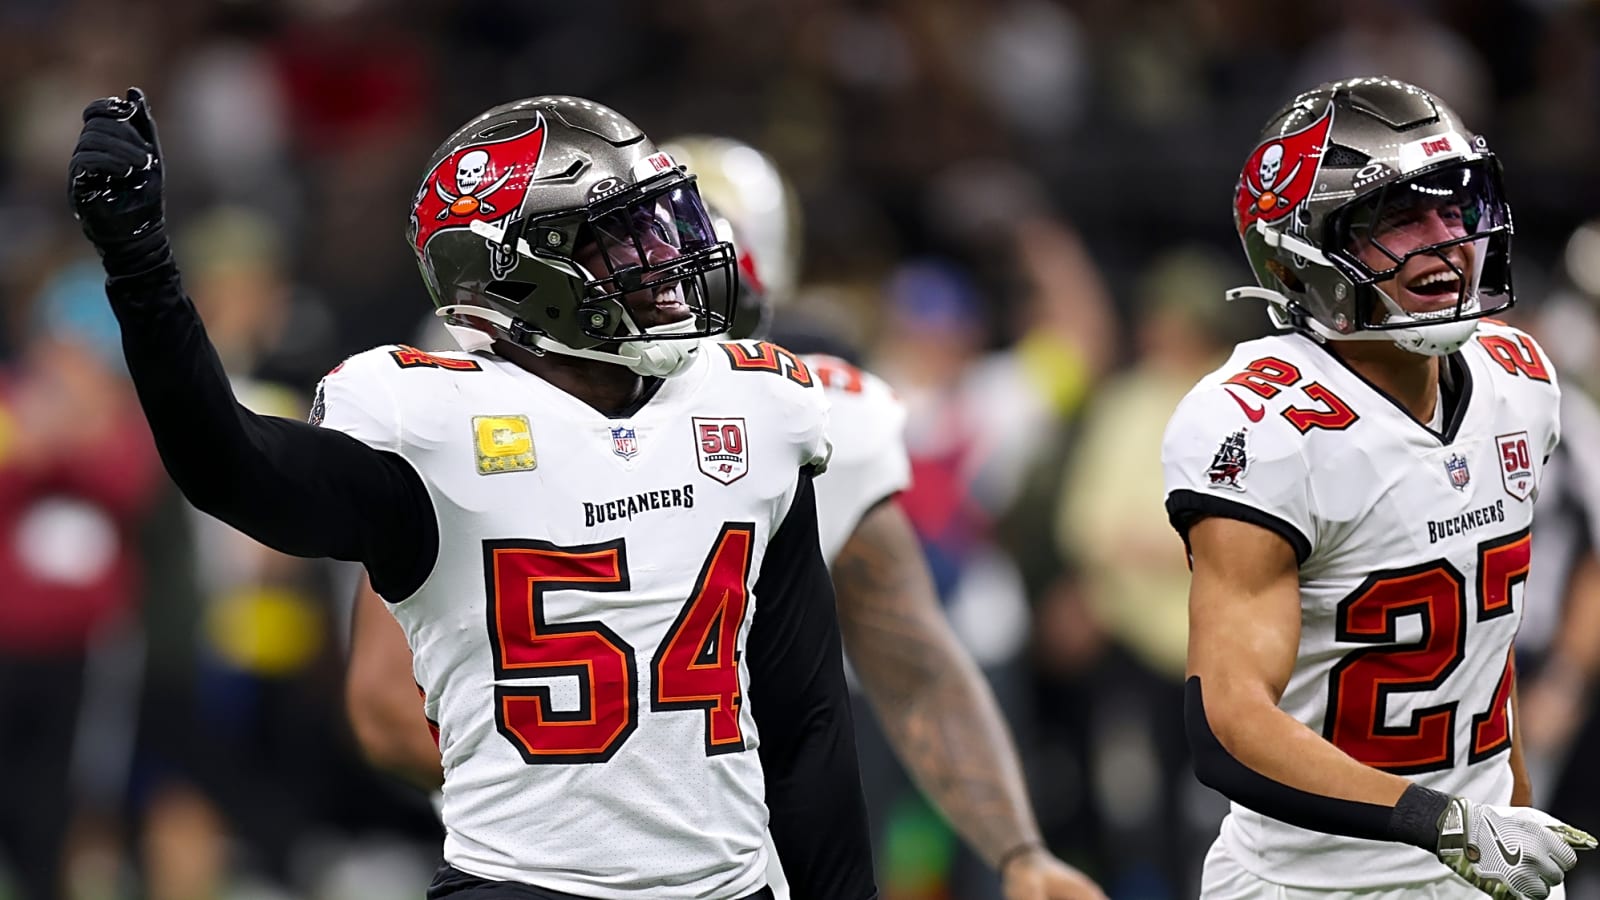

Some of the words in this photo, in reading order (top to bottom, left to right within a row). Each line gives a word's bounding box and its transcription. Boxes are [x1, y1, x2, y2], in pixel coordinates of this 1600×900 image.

[589, 184, 626, 203] OAKLEY
[1353, 169, 1391, 189] OAKLEY
[1220, 356, 1360, 436] 27
[478, 418, 530, 458] C
[615, 438, 639, 454] NFL
[699, 424, 743, 455] 50
[1501, 439, 1530, 472] 50
[582, 484, 694, 527] BUCCANEERS
[1427, 499, 1505, 544] BUCCANEERS
[482, 522, 756, 765] 54
[1321, 527, 1532, 776] 27
